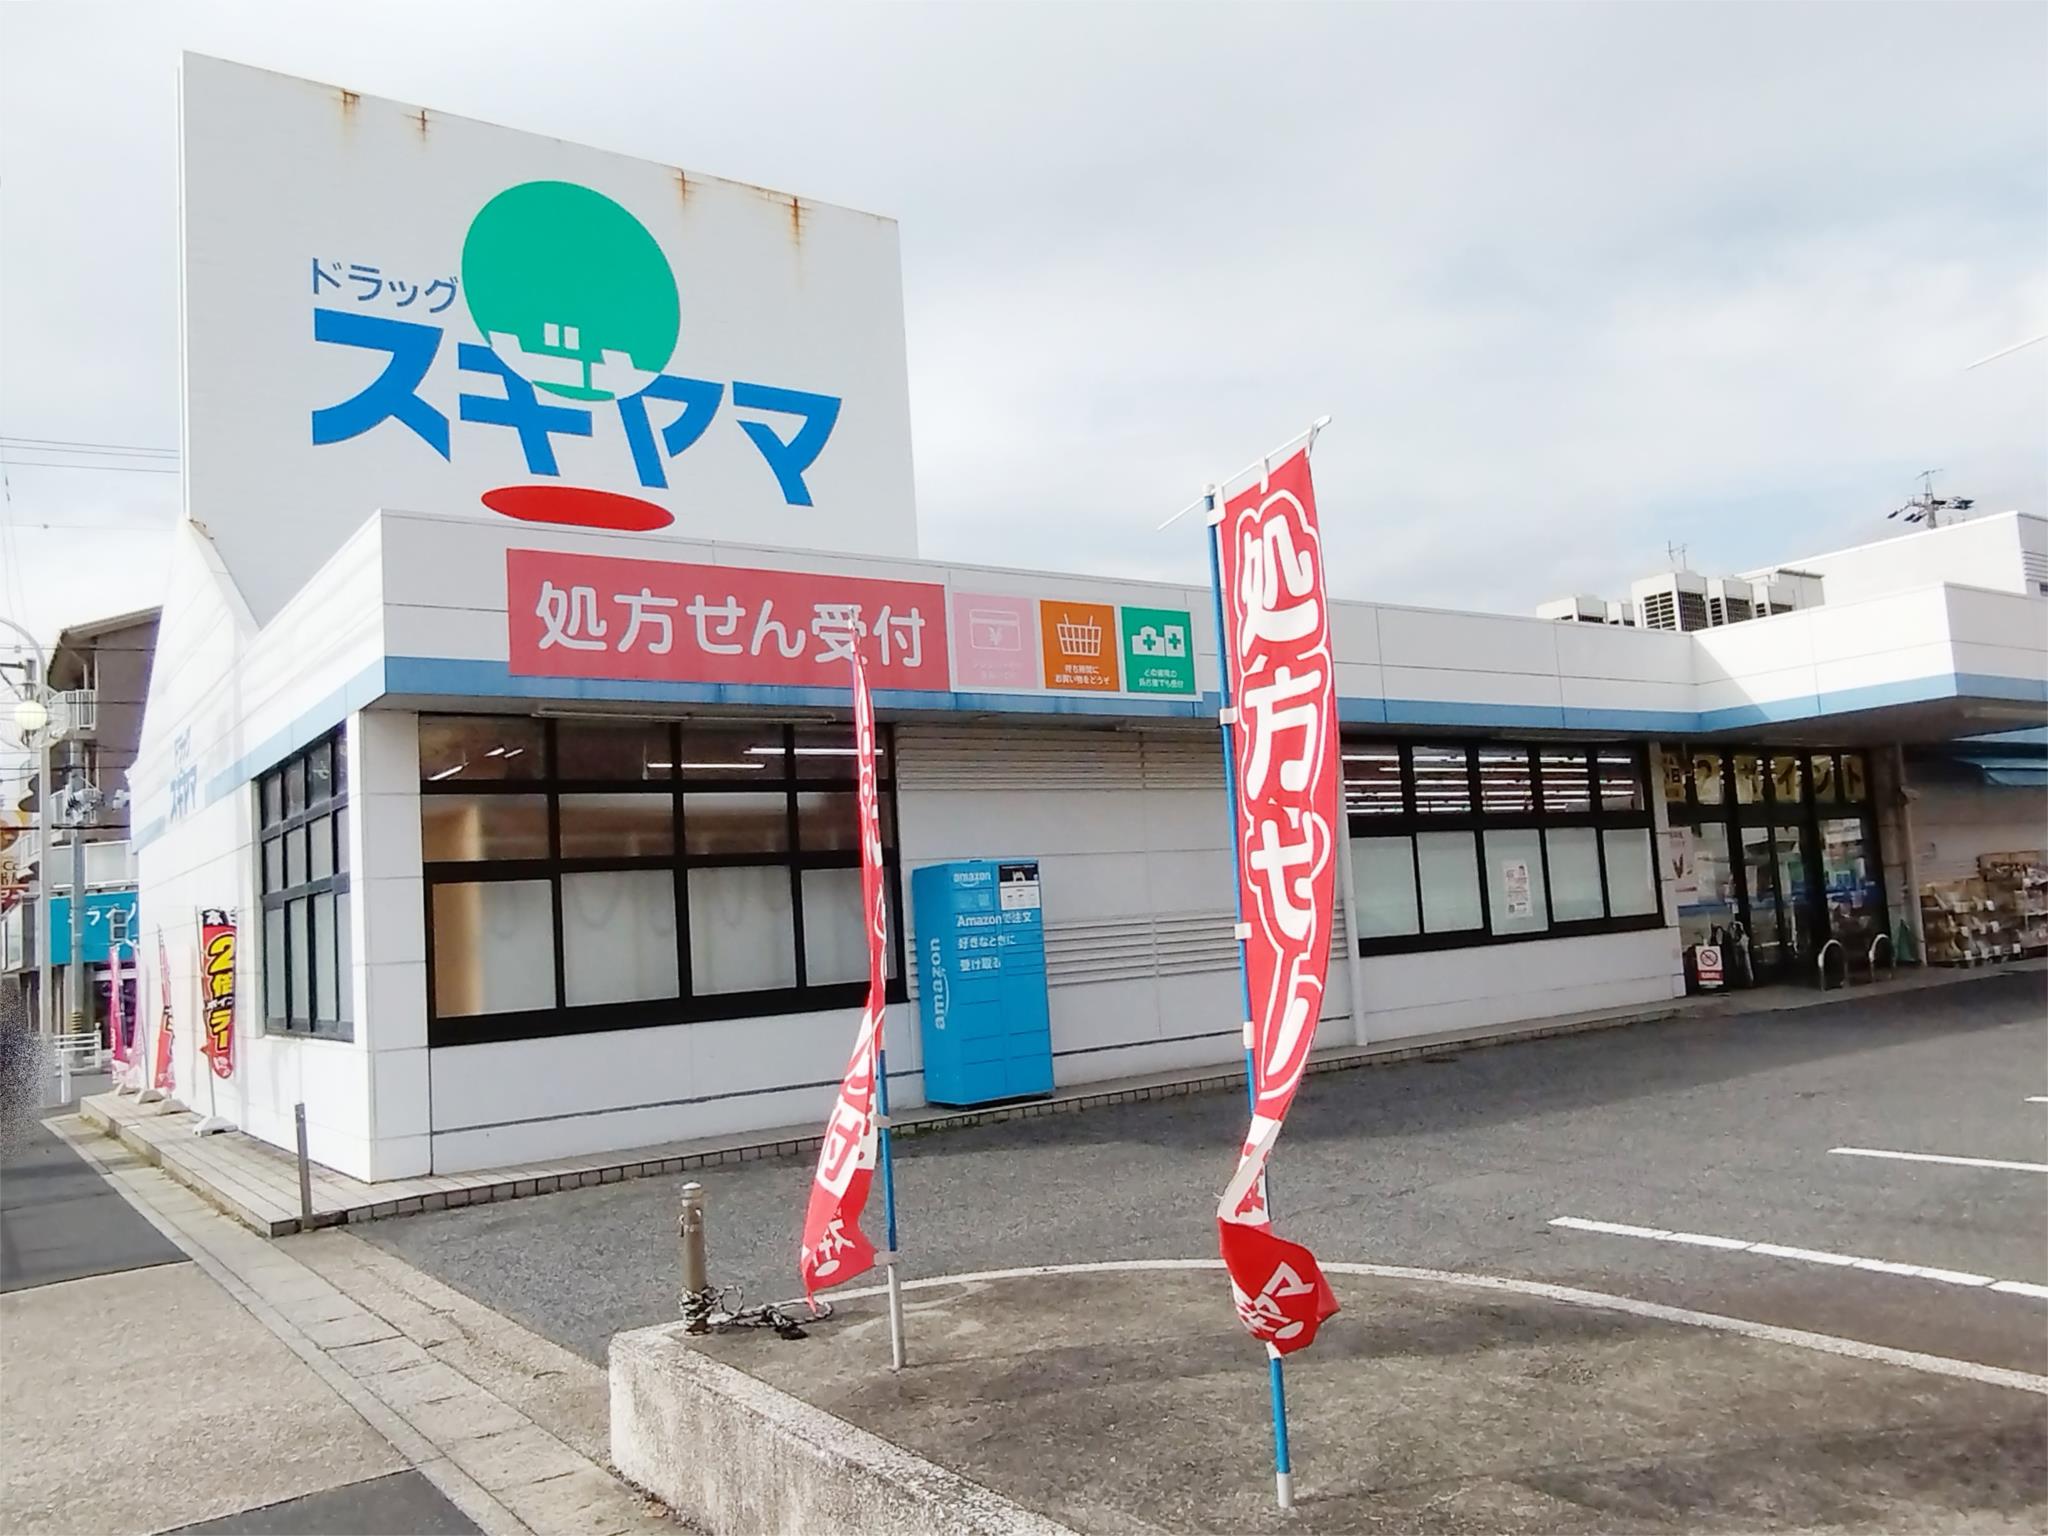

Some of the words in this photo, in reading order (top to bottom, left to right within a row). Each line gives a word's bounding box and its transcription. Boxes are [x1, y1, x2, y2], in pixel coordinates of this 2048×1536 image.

[311, 257, 459, 313] ドラッグ
[311, 307, 842, 507] スギヤマ
[535, 581, 926, 668] 処方せん受付
[953, 872, 991, 883] amazon
[957, 912, 1032, 927] Amazonで注文
[959, 935, 1016, 949] 好きなときに
[960, 957, 1001, 971] 受け取る
[930, 938, 945, 1029] amazon
